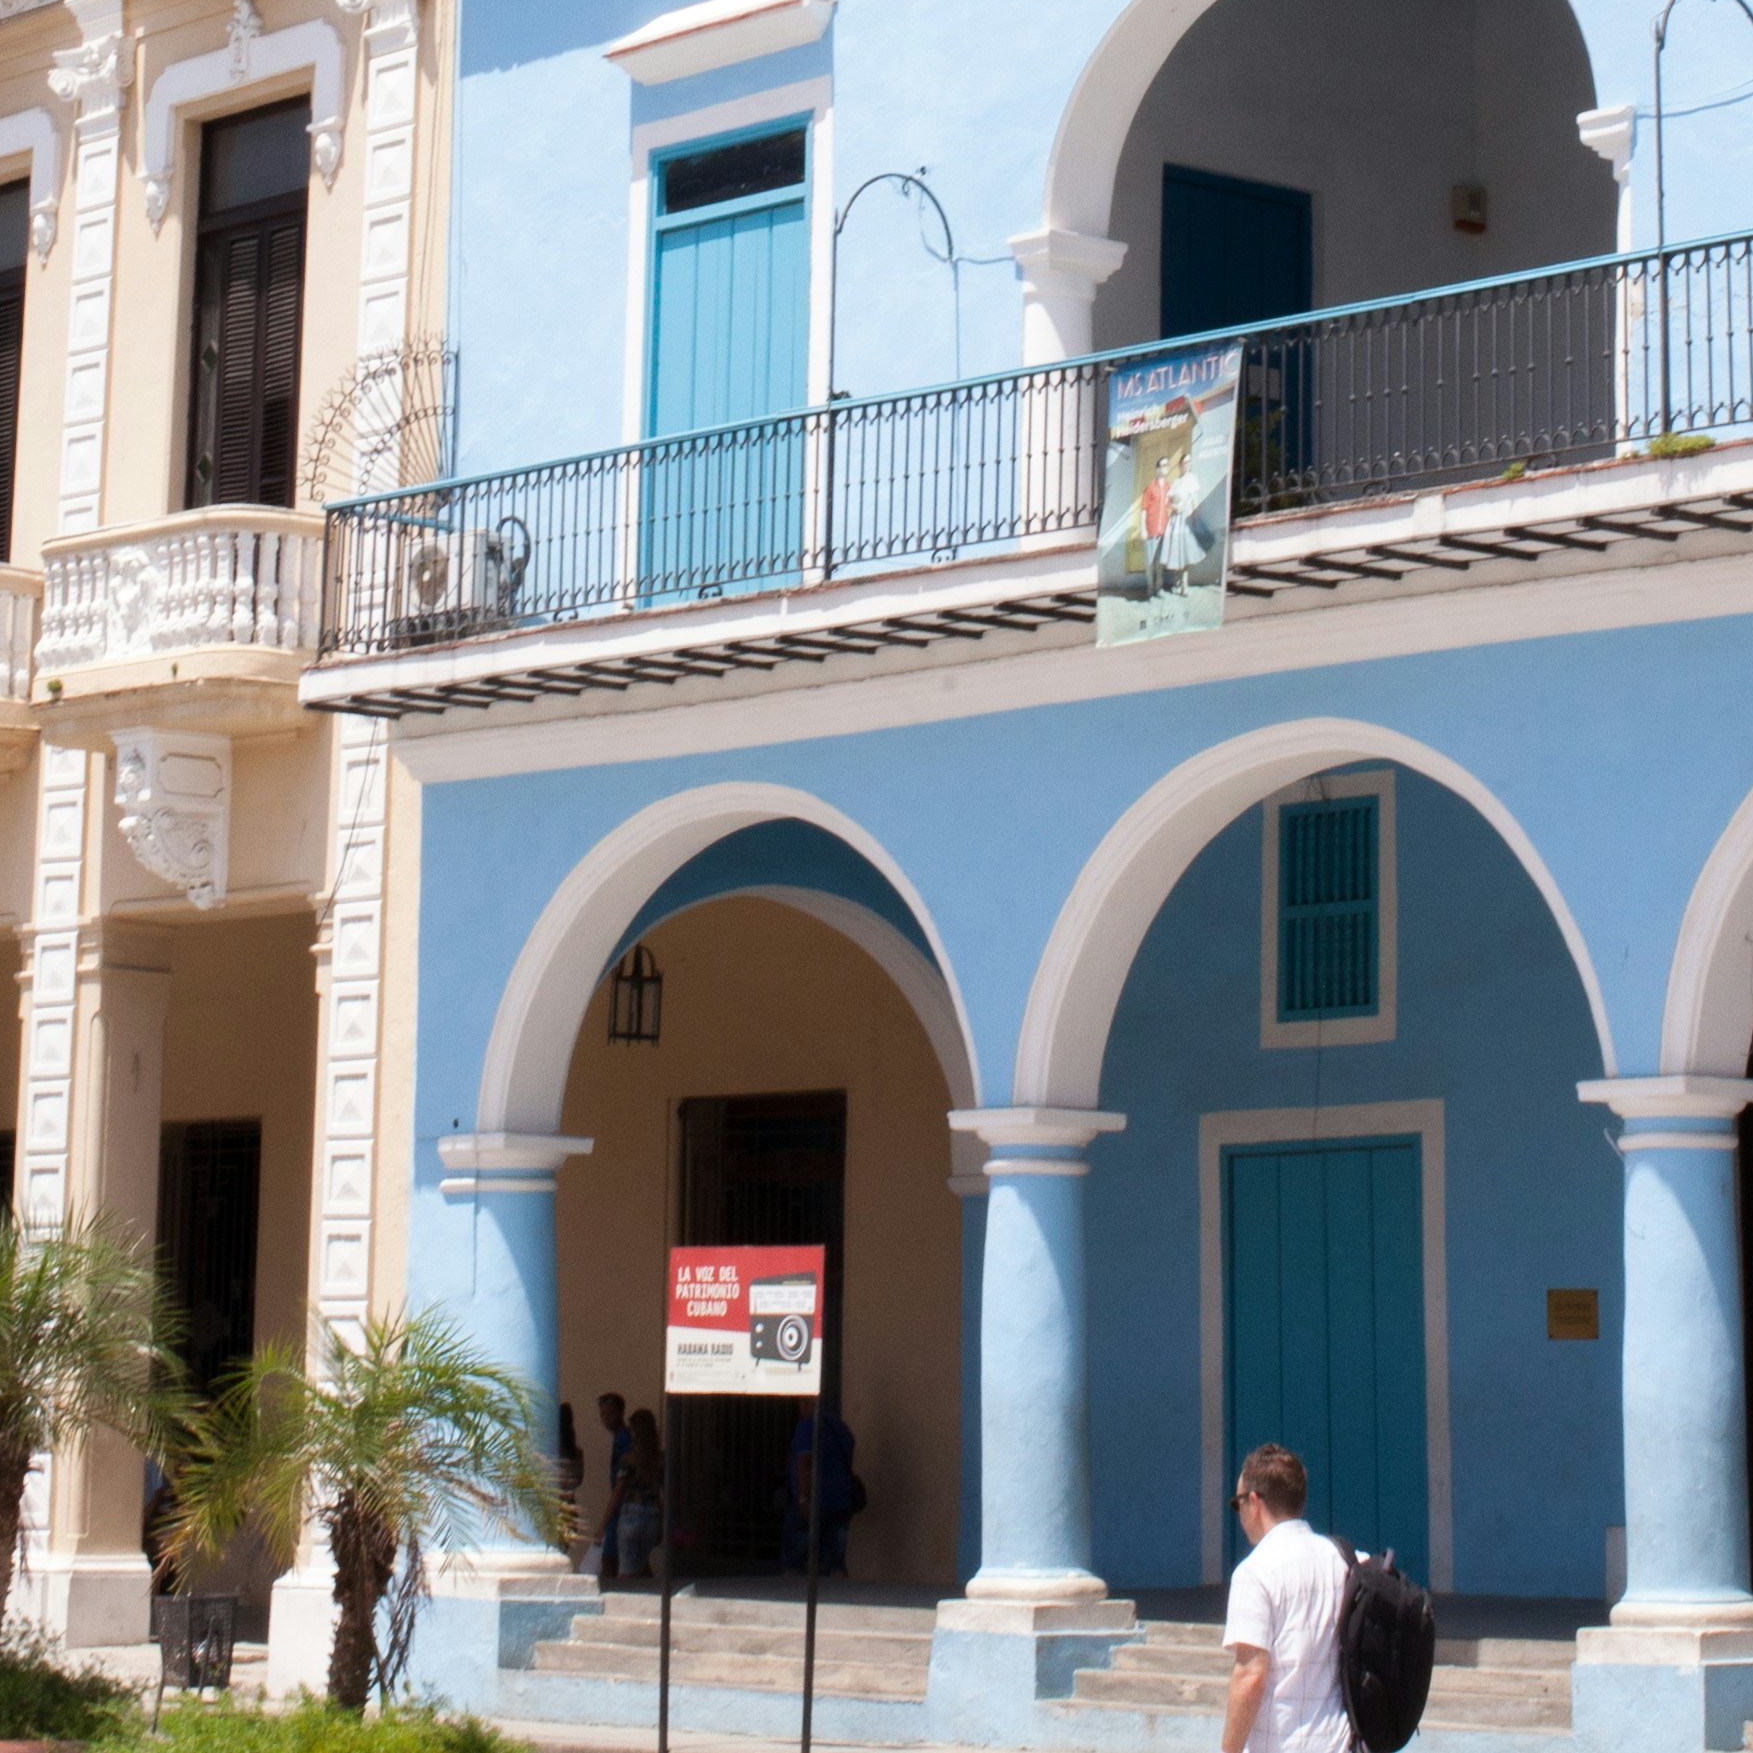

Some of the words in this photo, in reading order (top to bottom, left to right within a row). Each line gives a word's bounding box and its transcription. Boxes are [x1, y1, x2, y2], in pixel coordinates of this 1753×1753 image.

[1117, 371, 1143, 399] MS
[1146, 348, 1240, 393] ATLANTIC
[677, 1266, 691, 1282] LA
[695, 1266, 715, 1282] VOZ
[719, 1265, 738, 1281] DEL
[675, 1282, 740, 1299] PATRIMONIO
[686, 1300, 728, 1317] CUBANO
[677, 1343, 708, 1356] HABANA
[710, 1343, 734, 1356] RADIO
